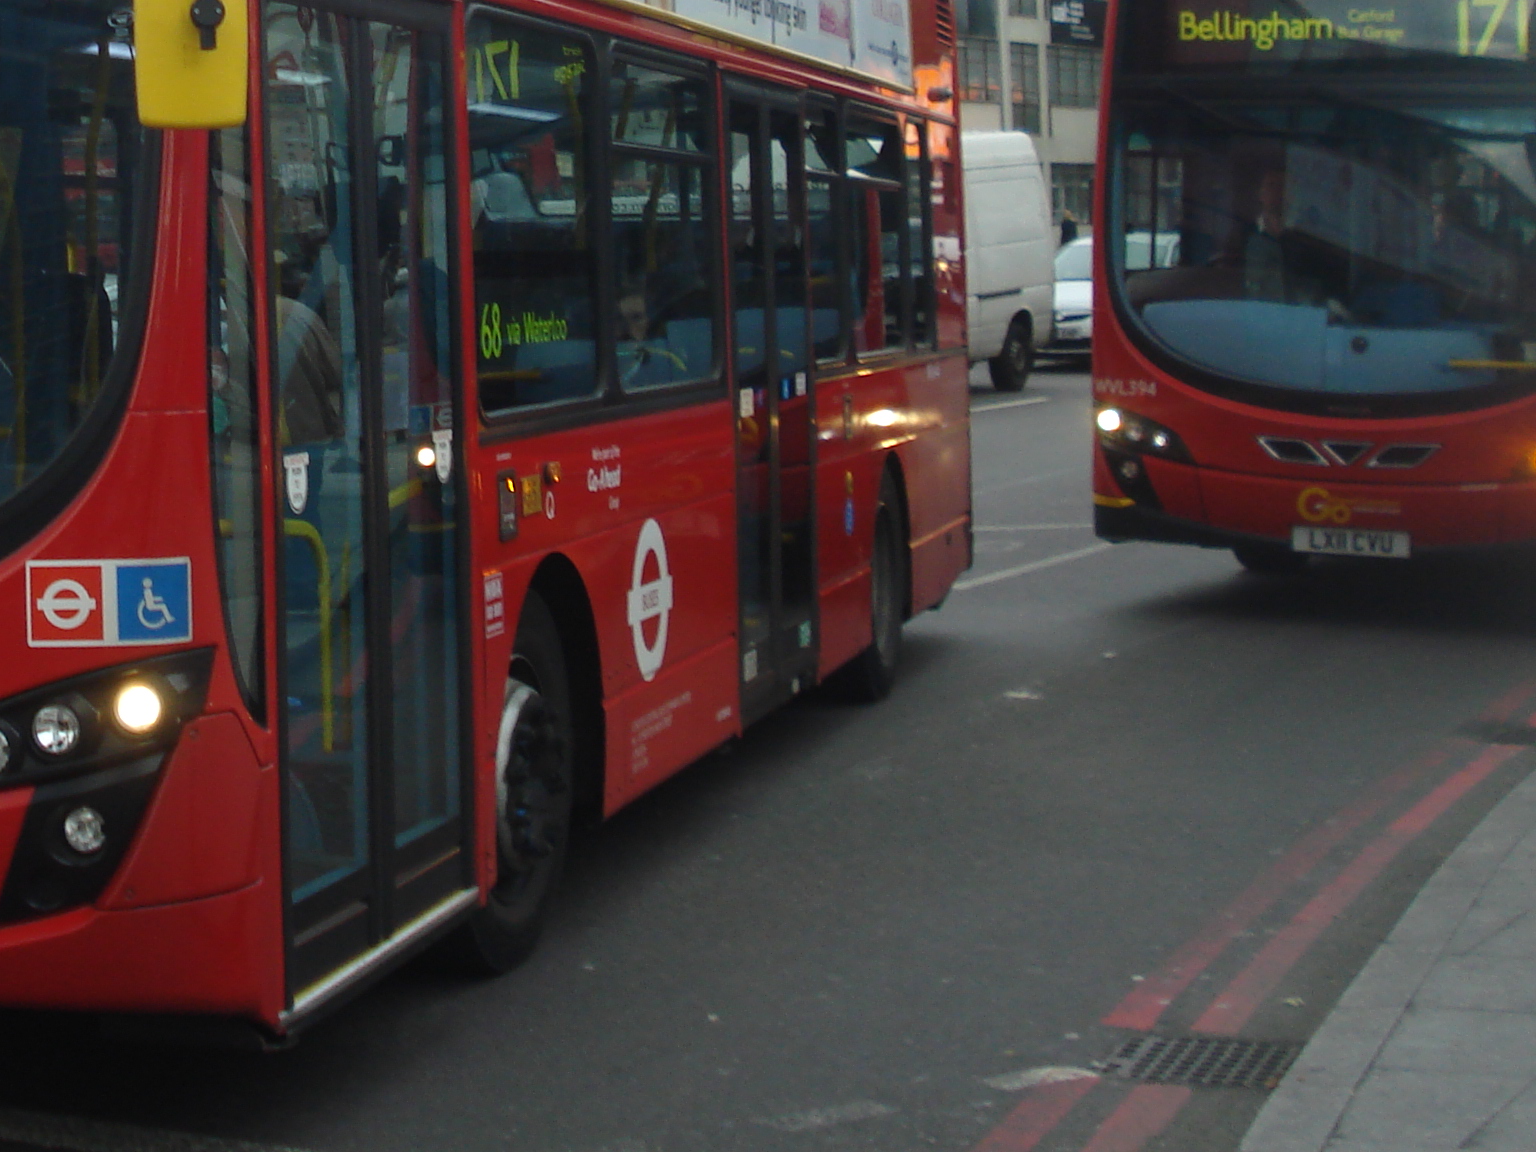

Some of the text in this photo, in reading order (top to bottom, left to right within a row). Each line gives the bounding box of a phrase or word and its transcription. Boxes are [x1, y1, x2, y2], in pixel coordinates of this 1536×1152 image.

[1178, 10, 1334, 51] Bellingham
[480, 301, 568, 360] 68 via Waterloo
